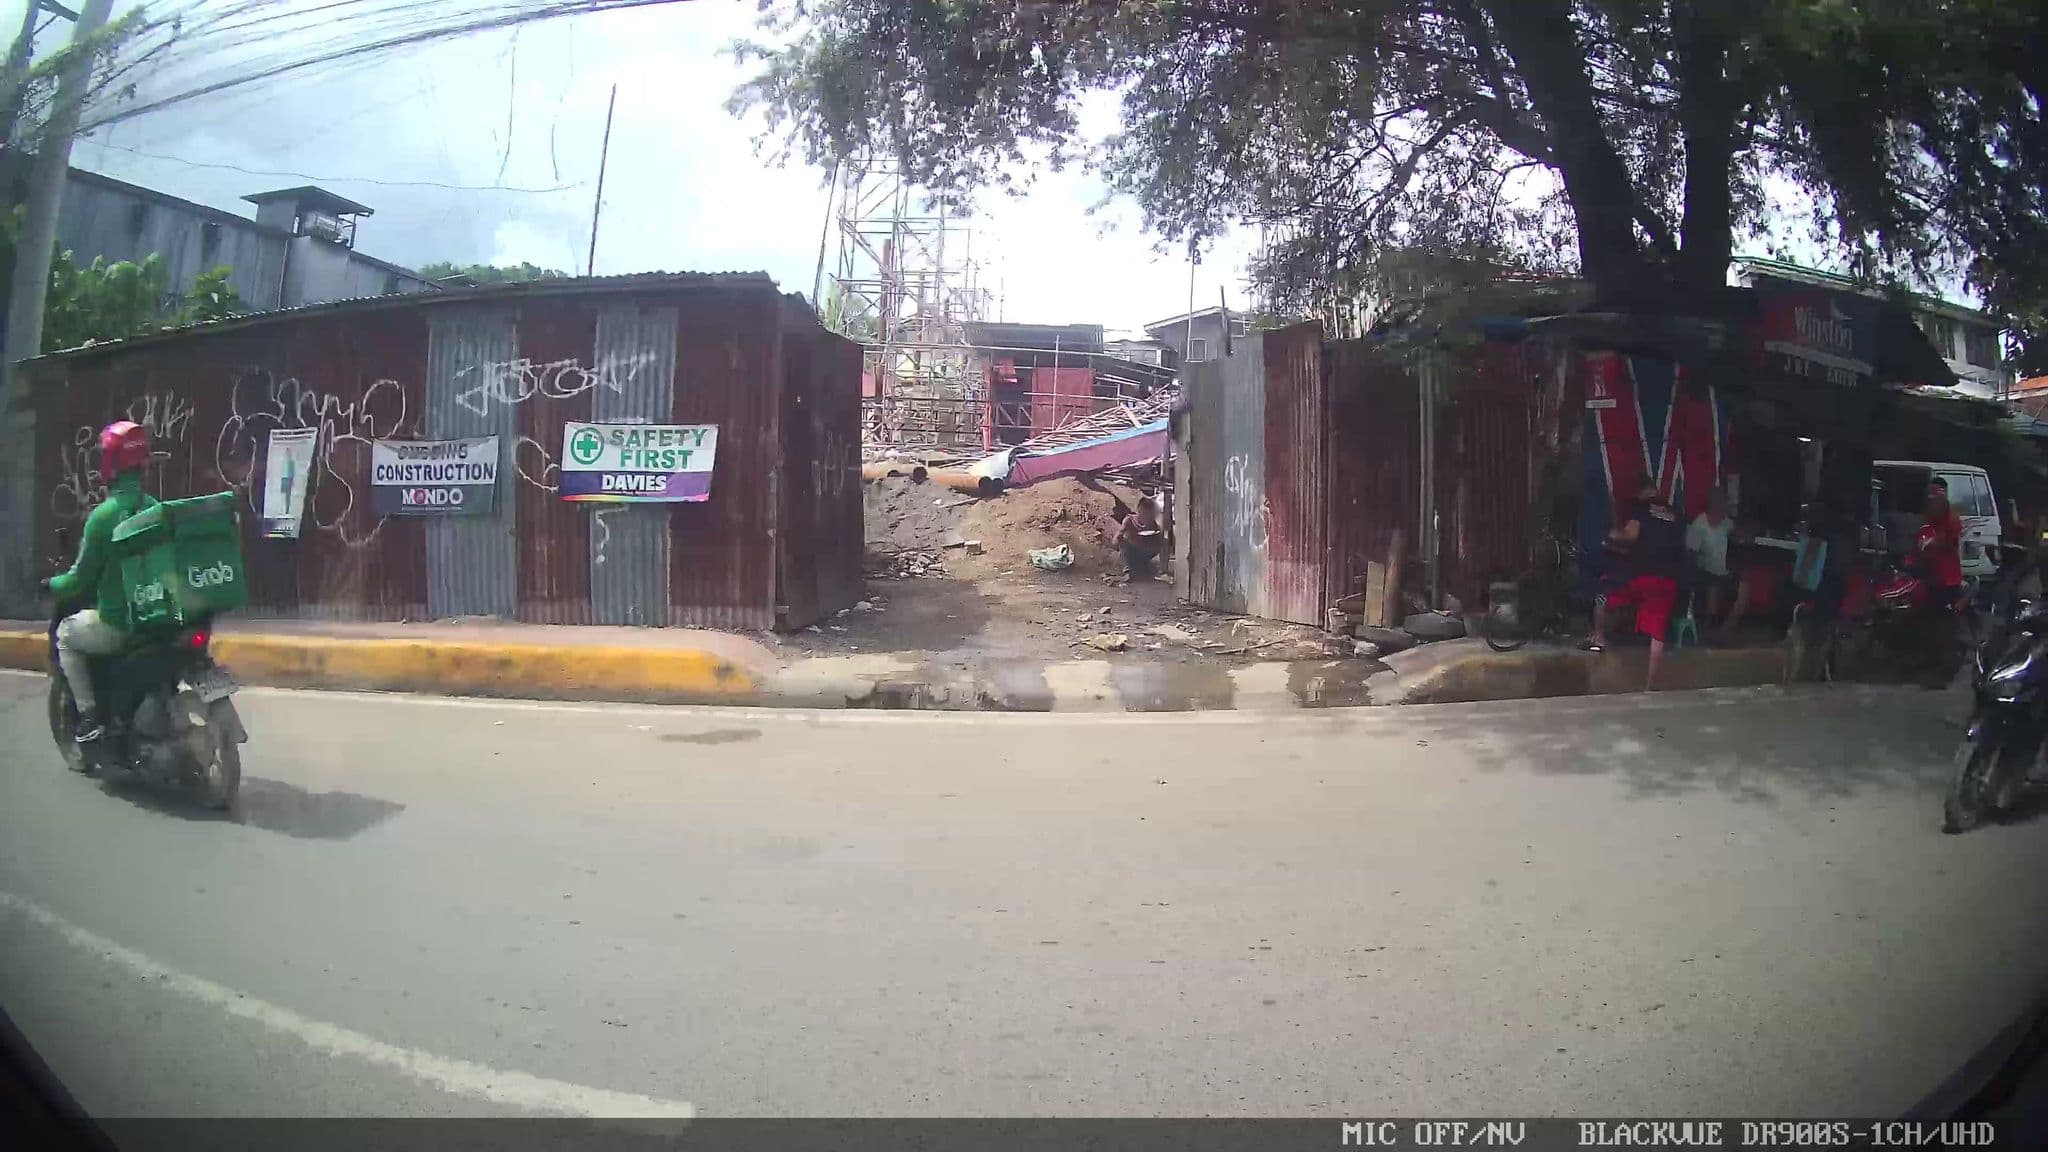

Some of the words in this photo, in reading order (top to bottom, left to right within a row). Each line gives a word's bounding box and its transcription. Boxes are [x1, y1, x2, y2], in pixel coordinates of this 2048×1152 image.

[1794, 303, 1853, 352] Winston
[609, 428, 708, 448] SAFETY
[619, 449, 694, 469] FIRST
[376, 463, 494, 481] CONSTRUCTION
[601, 473, 667, 491] DAVIES
[402, 487, 464, 505] MONDO
[188, 560, 234, 588] Grab
